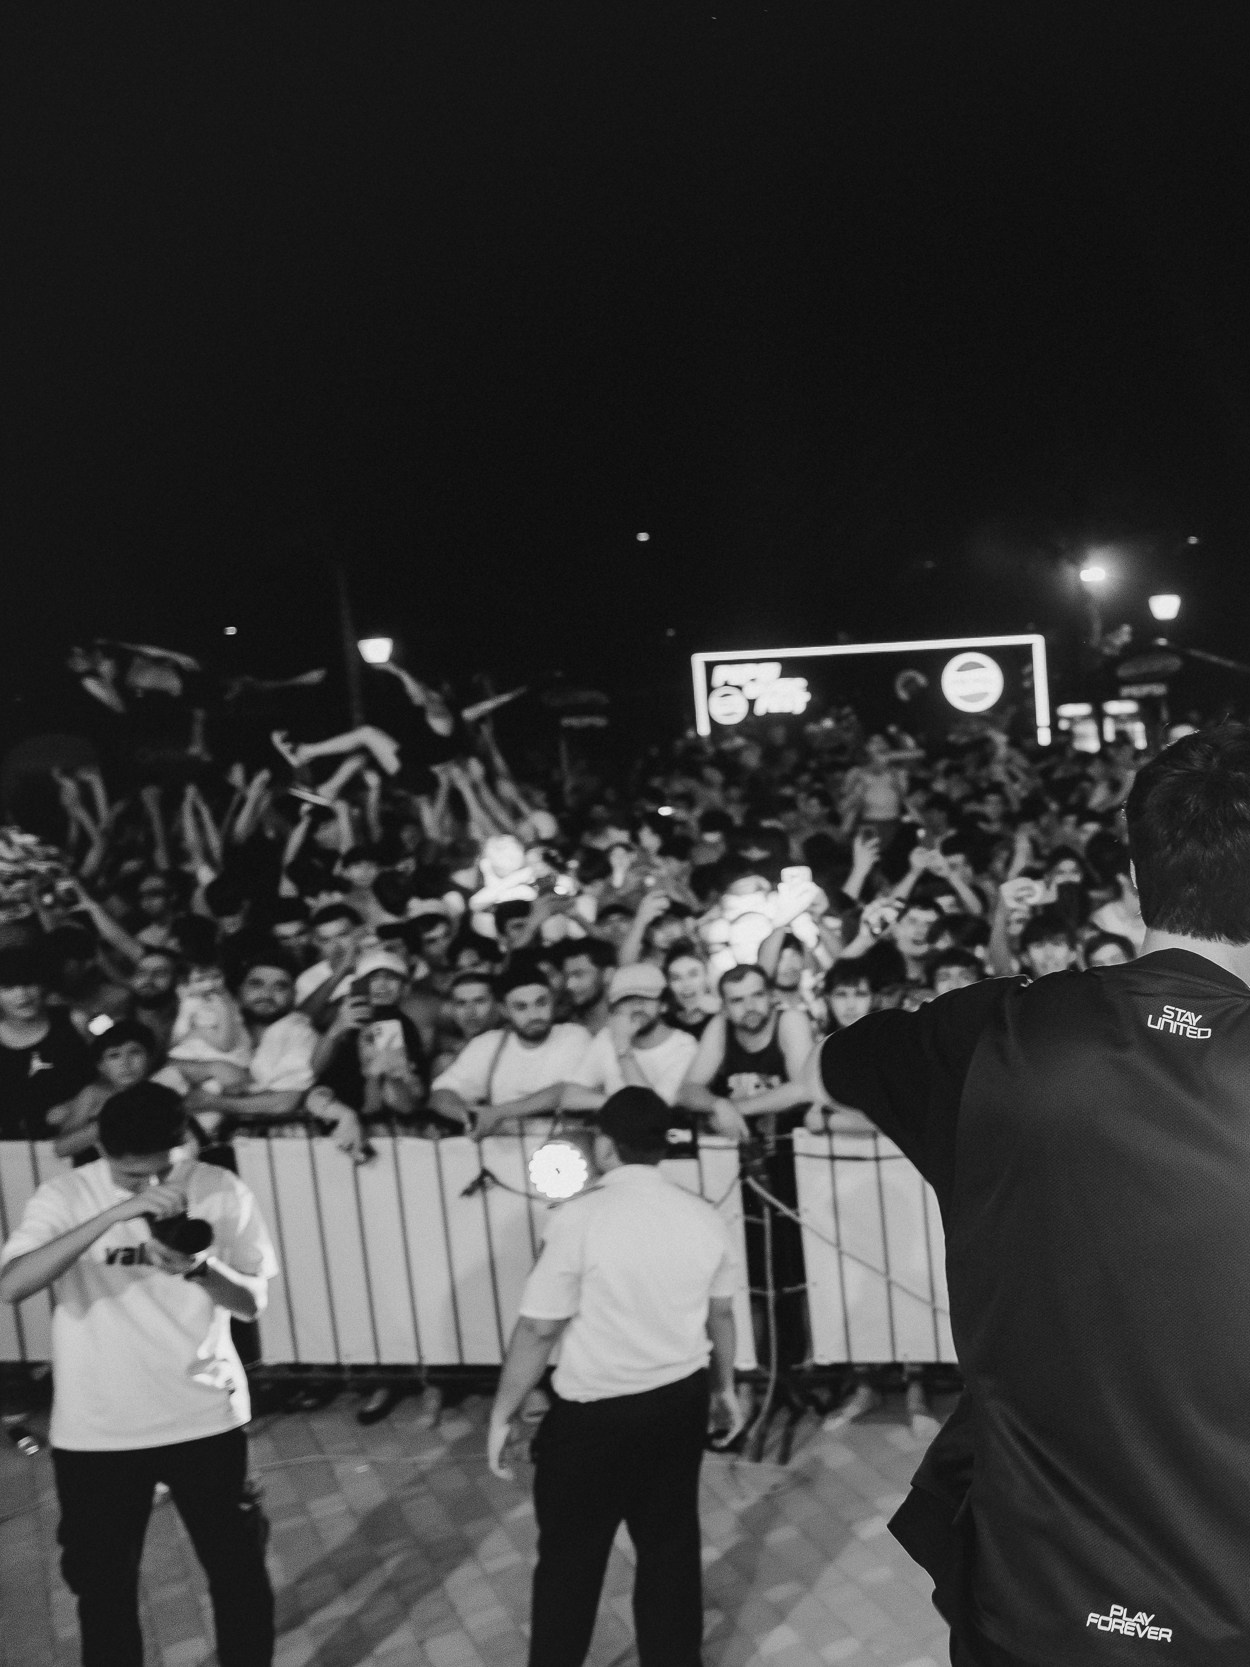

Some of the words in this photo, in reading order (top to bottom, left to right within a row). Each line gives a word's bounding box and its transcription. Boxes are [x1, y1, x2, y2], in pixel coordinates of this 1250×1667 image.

[1147, 1014, 1212, 1039] UNITED
[1162, 1005, 1202, 1026] STAY
[1109, 1604, 1155, 1626] PLAY
[1086, 1612, 1173, 1642] FOREVER
